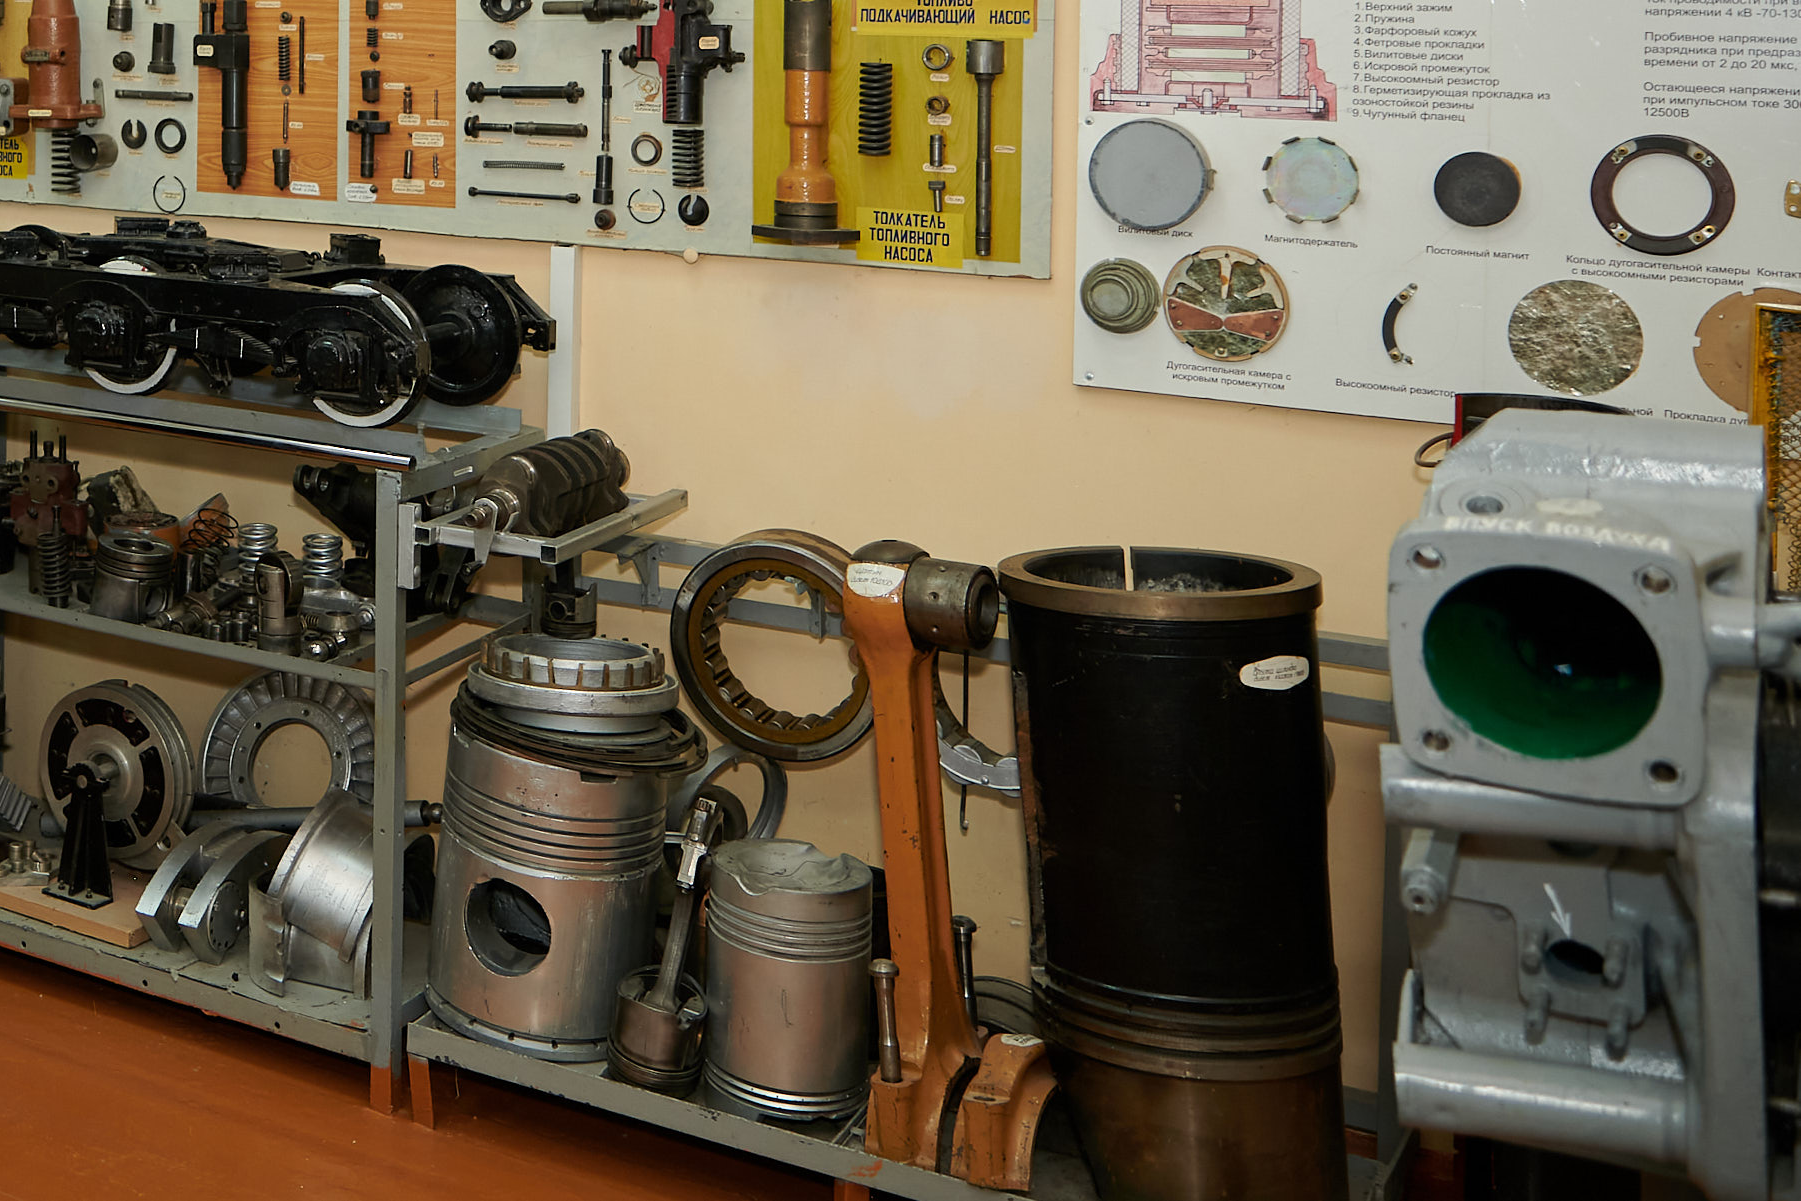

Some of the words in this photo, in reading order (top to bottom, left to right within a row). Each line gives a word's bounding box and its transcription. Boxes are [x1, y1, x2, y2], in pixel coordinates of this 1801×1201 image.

[1416, 4, 1453, 12] зажим
[1645, 8, 1721, 17] напряжении
[861, 8, 975, 25] ПОДКАЧИВАЮЩИЙ
[989, 10, 1031, 24] НАСОС
[1443, 29, 1477, 37] кожух
[1644, 32, 1714, 42] Пробивное
[1719, 35, 1797, 44] напряжение
[1424, 40, 1485, 50] прокладки
[1644, 47, 1717, 55] разрядника
[1430, 52, 1464, 61] диски
[1421, 64, 1490, 74] промежуток
[1644, 59, 1698, 68] времени
[1447, 77, 1499, 87] резистор
[1643, 82, 1725, 93] Остающееся
[1472, 90, 1534, 100] прокладка
[1352, 98, 1428, 108] озоностойкой
[1432, 101, 1474, 110] резины
[1669, 98, 1747, 108] импульсном
[1751, 100, 1779, 108] токе
[1420, 112, 1465, 122] фланец
[1644, 108, 1689, 118] 12500В
[873, 211, 946, 229] ТОЛКАТЕЛЬ
[869, 227, 949, 246] ТОПЛИВНОГО
[1118, 225, 1169, 237] Вилитовый
[1171, 230, 1193, 239] диск
[1265, 234, 1358, 249] Магнитодержатель
[884, 246, 933, 263] НАСОСА
[1426, 245, 1493, 258] Постоянный
[1496, 251, 1530, 260] магнит
[1566, 255, 1605, 267] Кольцо
[1609, 259, 1702, 273] дугогасительной
[1706, 266, 1750, 276] камеры
[1581, 268, 1664, 282] высокоомными
[1670, 274, 1744, 287] резисторами
[1167, 361, 1246, 376] Дугогасительная
[1248, 370, 1284, 379] камера
[1172, 373, 1218, 384] искровым
[1220, 379, 1285, 390] промежутком
[1336, 378, 1407, 393] Высокоомный
[1409, 387, 1456, 398] резистор
[1664, 409, 1726, 424] Прокладка
